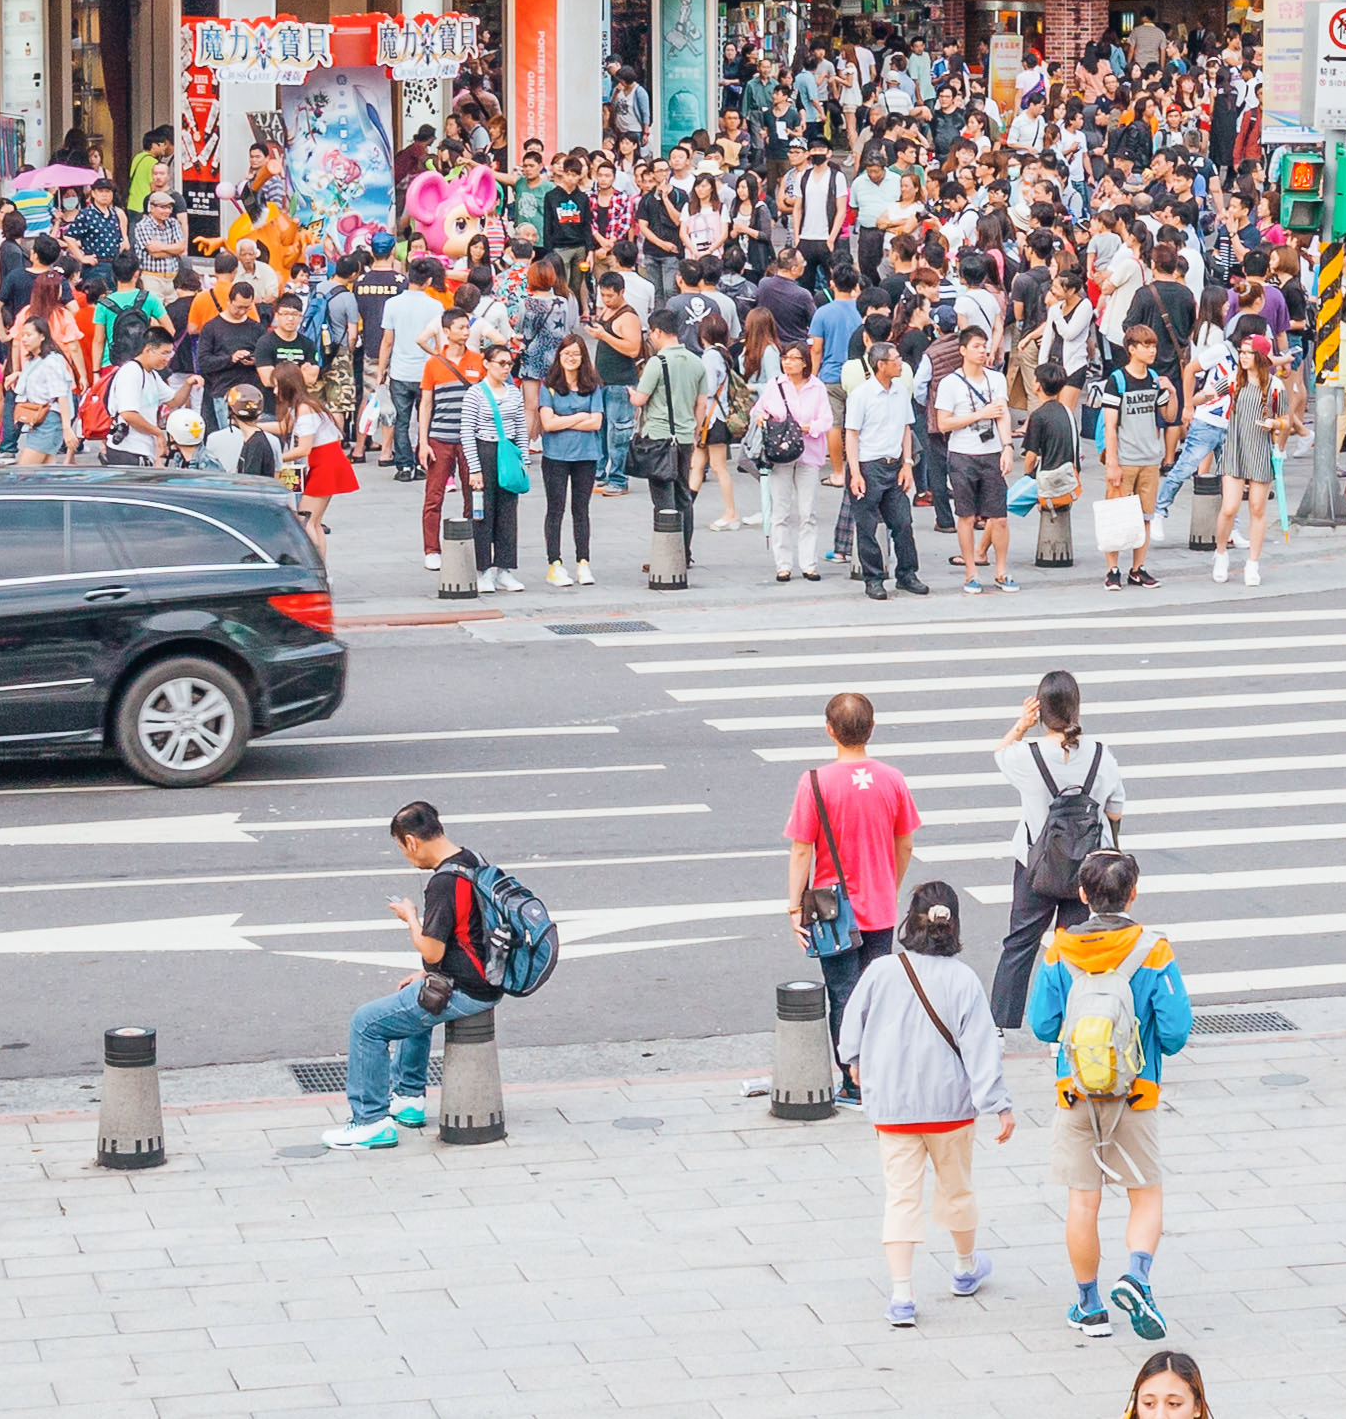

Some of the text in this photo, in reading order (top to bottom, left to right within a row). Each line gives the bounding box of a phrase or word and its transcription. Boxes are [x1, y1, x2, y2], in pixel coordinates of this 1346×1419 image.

[200, 22, 328, 64] 魔力寶貝
[380, 18, 478, 62] 魔力寶貝
[537, 30, 546, 61] PORTER
[527, 71, 536, 104] GRAND
